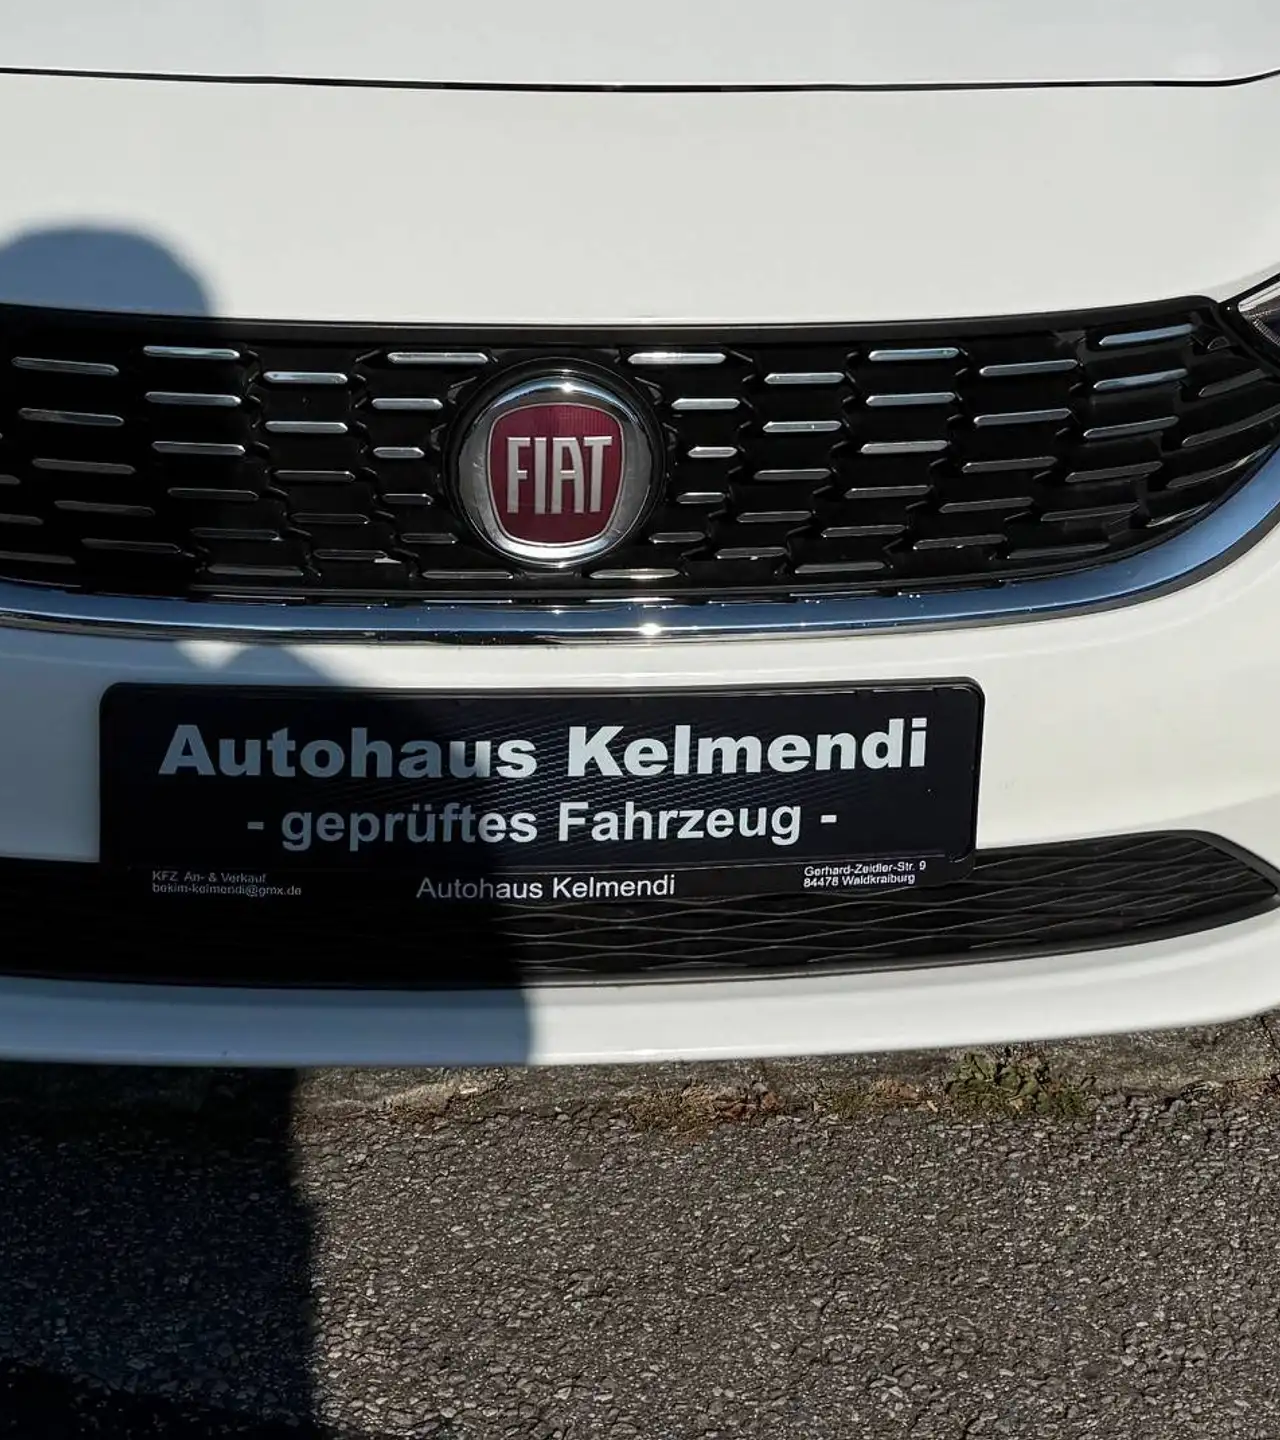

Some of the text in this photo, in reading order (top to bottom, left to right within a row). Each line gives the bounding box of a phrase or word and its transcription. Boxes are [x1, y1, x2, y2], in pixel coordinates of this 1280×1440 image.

[506, 435, 613, 515] FIAT
[158, 717, 928, 779] Autohaus Kelmendi
[281, 802, 538, 852] geprüftes
[558, 800, 802, 846] Fahrzeug
[152, 870, 178, 882] KFZ
[208, 872, 218, 883] &
[221, 872, 268, 884] Verkauf
[919, 860, 927, 871] 9
[416, 874, 676, 900] Autohaus Kelmendi
[803, 873, 916, 888] 84478 Waldkraiburg
